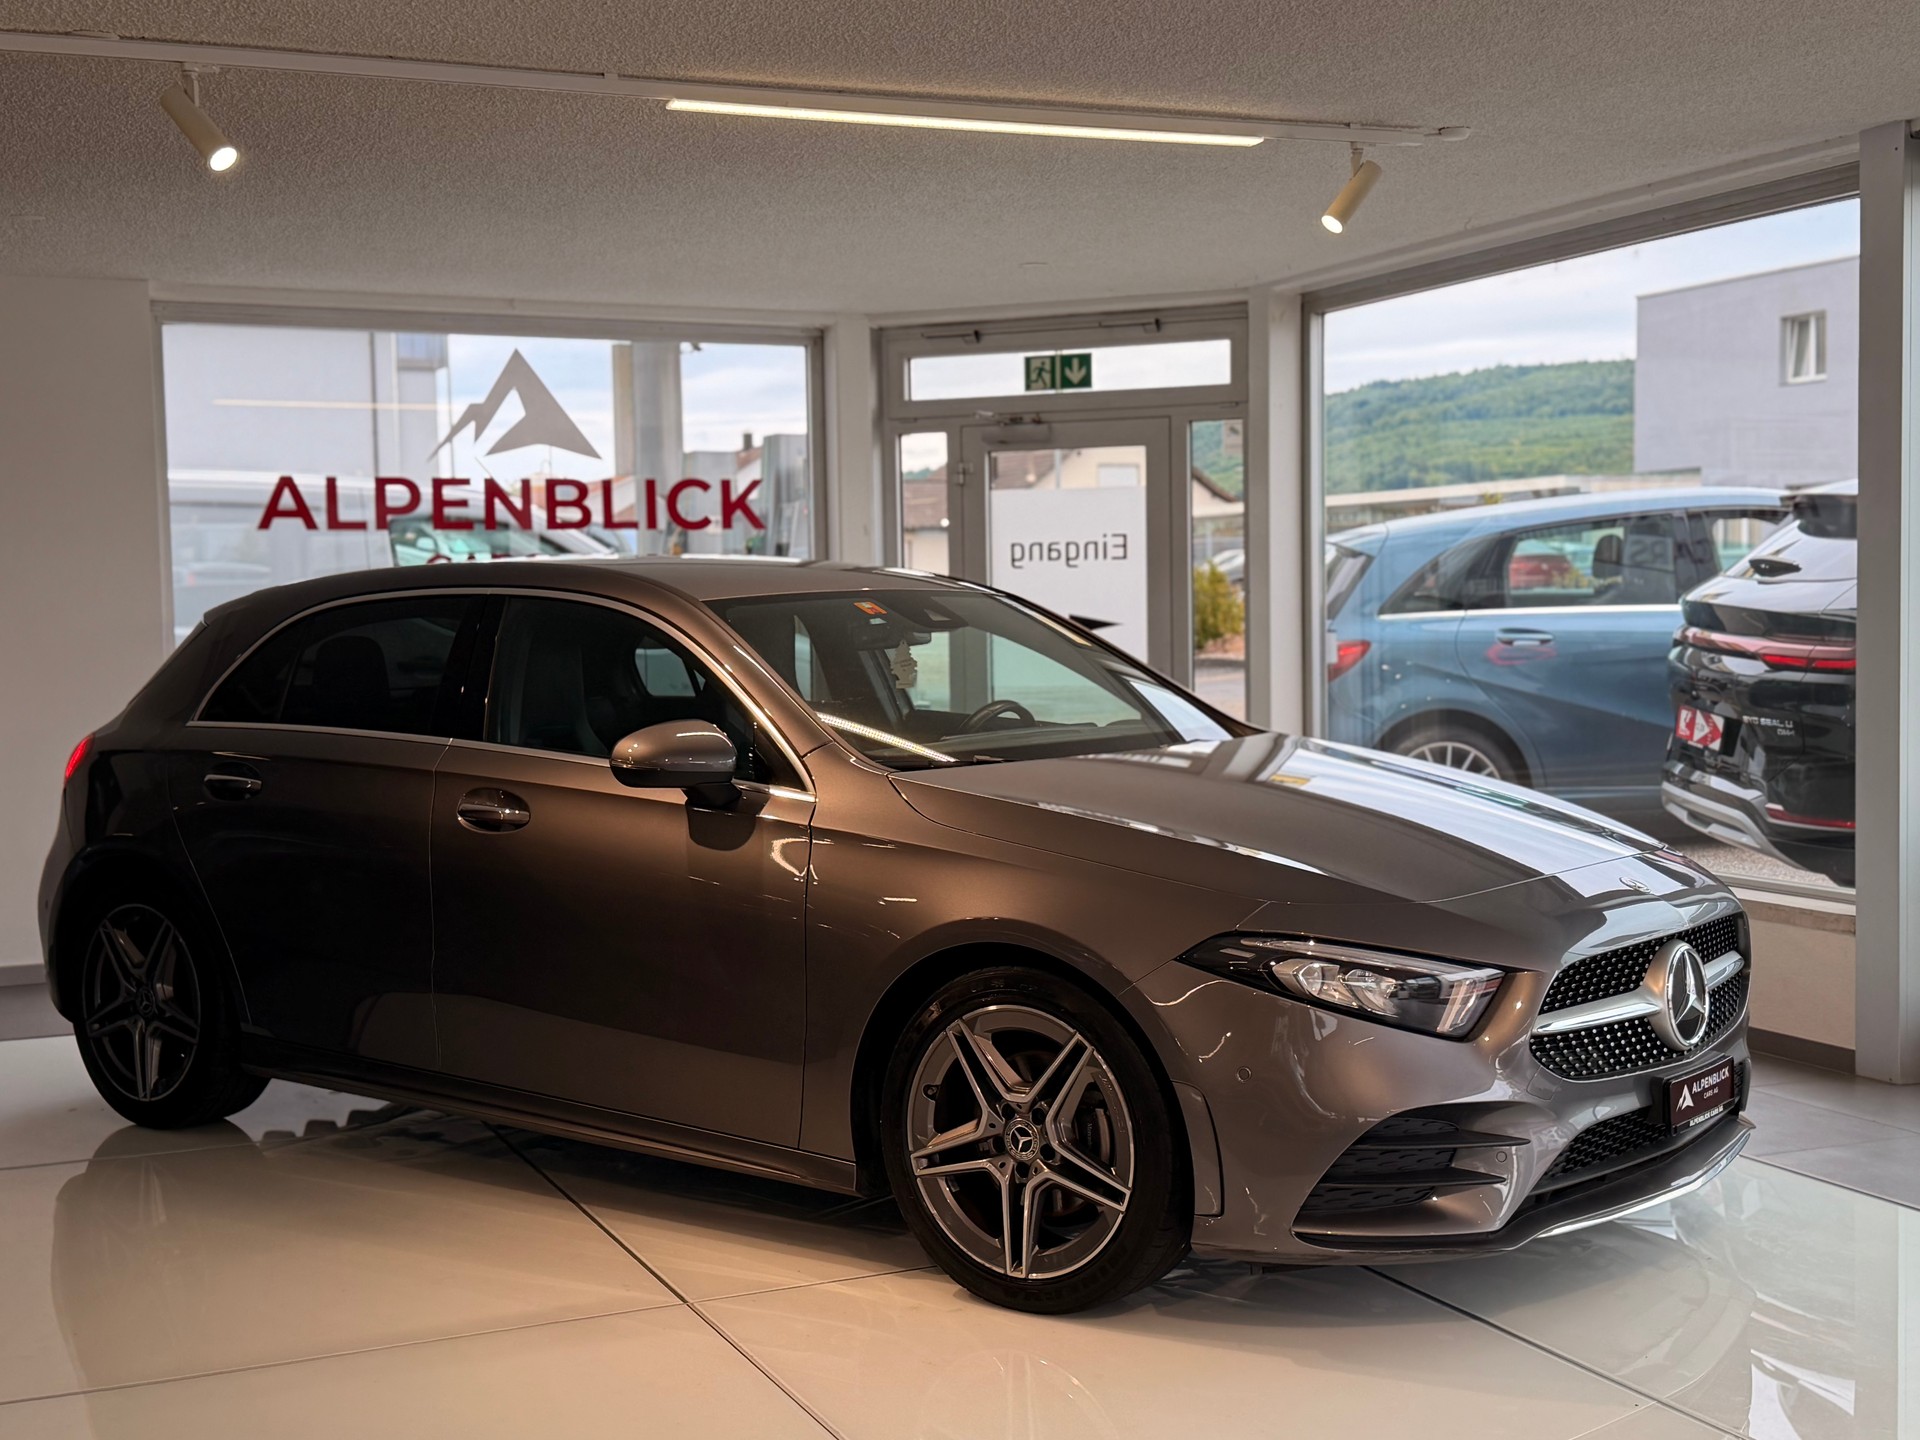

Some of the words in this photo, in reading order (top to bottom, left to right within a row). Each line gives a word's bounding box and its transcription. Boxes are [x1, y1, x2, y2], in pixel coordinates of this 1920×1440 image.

[258, 476, 766, 531] ALPENBLICK
[1691, 1066, 1730, 1094] ALPENBLICK
[1703, 1089, 1713, 1099] CARS
[1713, 1086, 1719, 1094] AG
